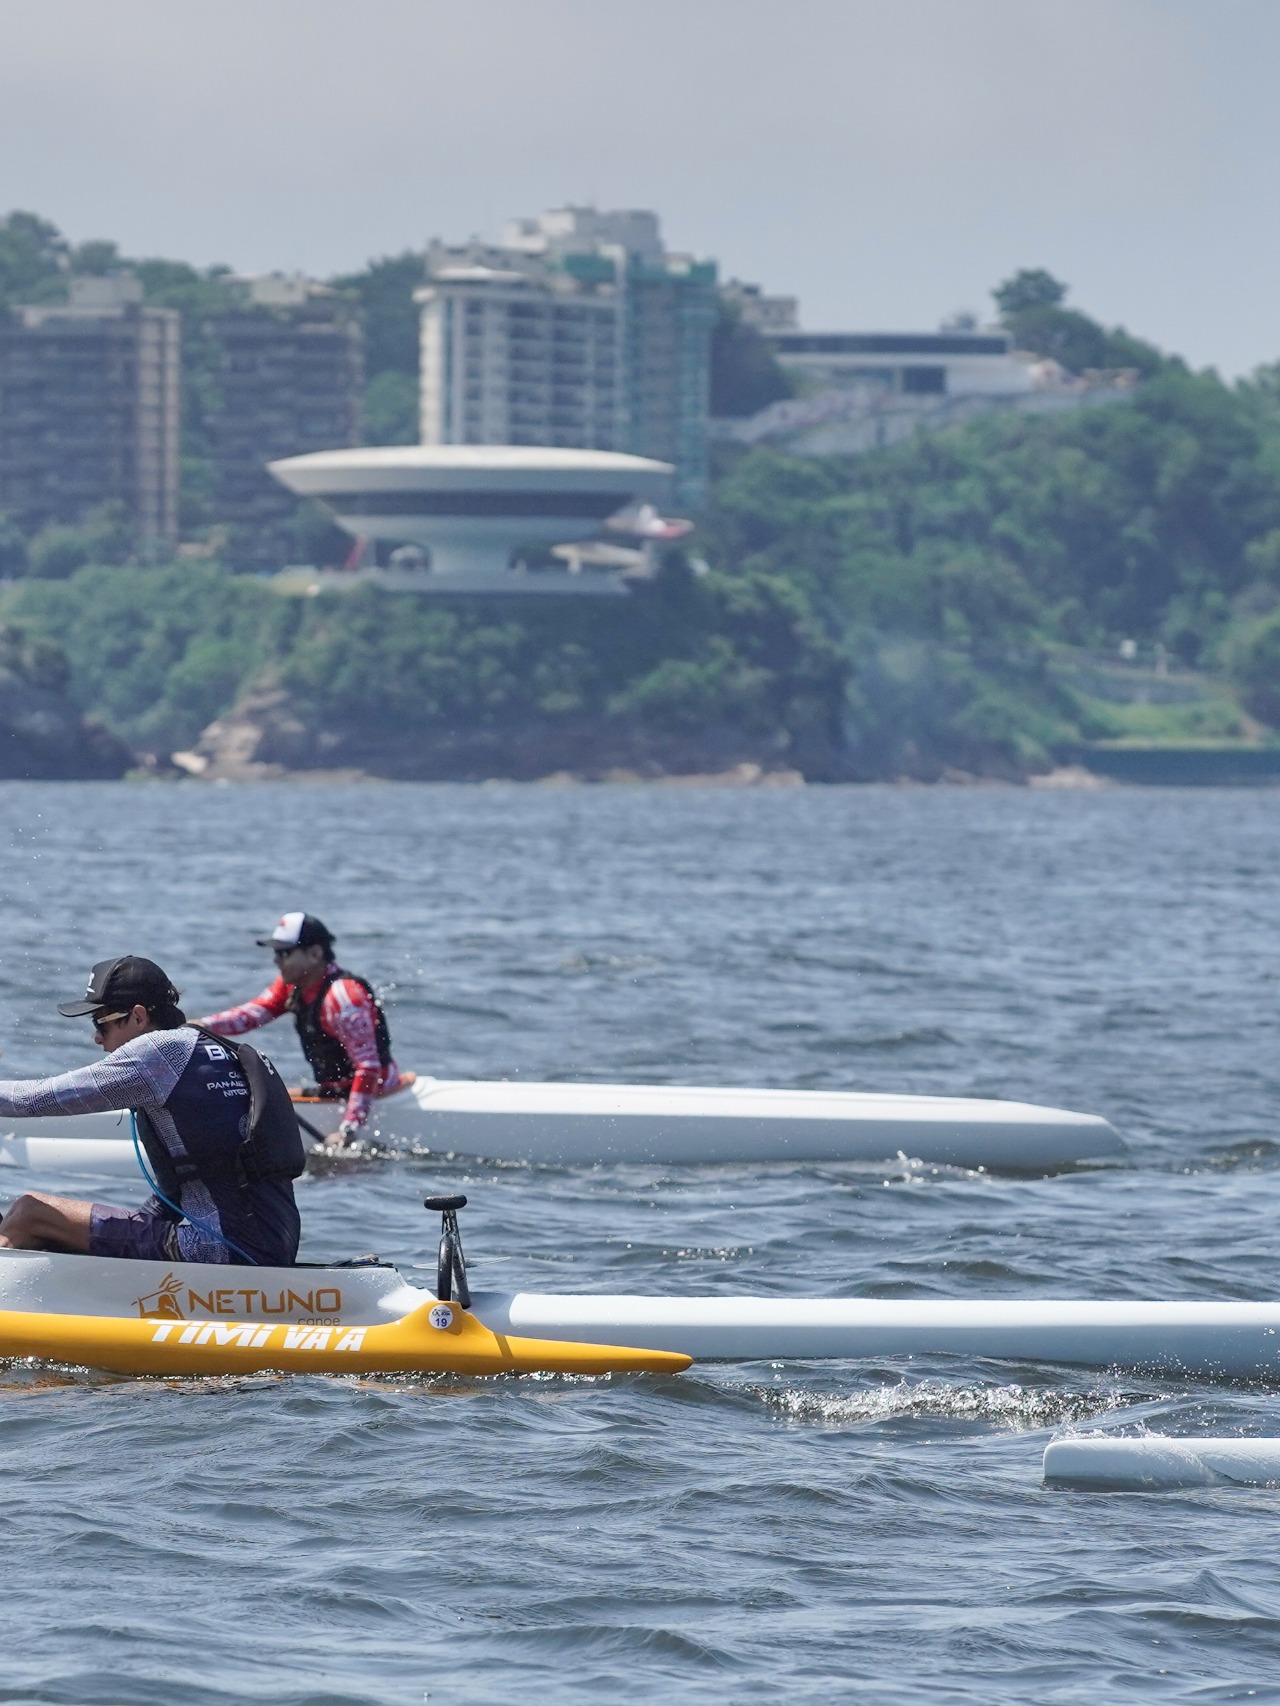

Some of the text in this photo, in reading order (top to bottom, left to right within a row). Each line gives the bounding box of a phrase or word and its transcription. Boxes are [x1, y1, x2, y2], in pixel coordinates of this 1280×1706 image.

[188, 1288, 341, 1314] NETUNO
[297, 1317, 341, 1327] canoe
[435, 1317, 448, 1328] 19
[147, 1319, 368, 1352] TIMI VA'A
